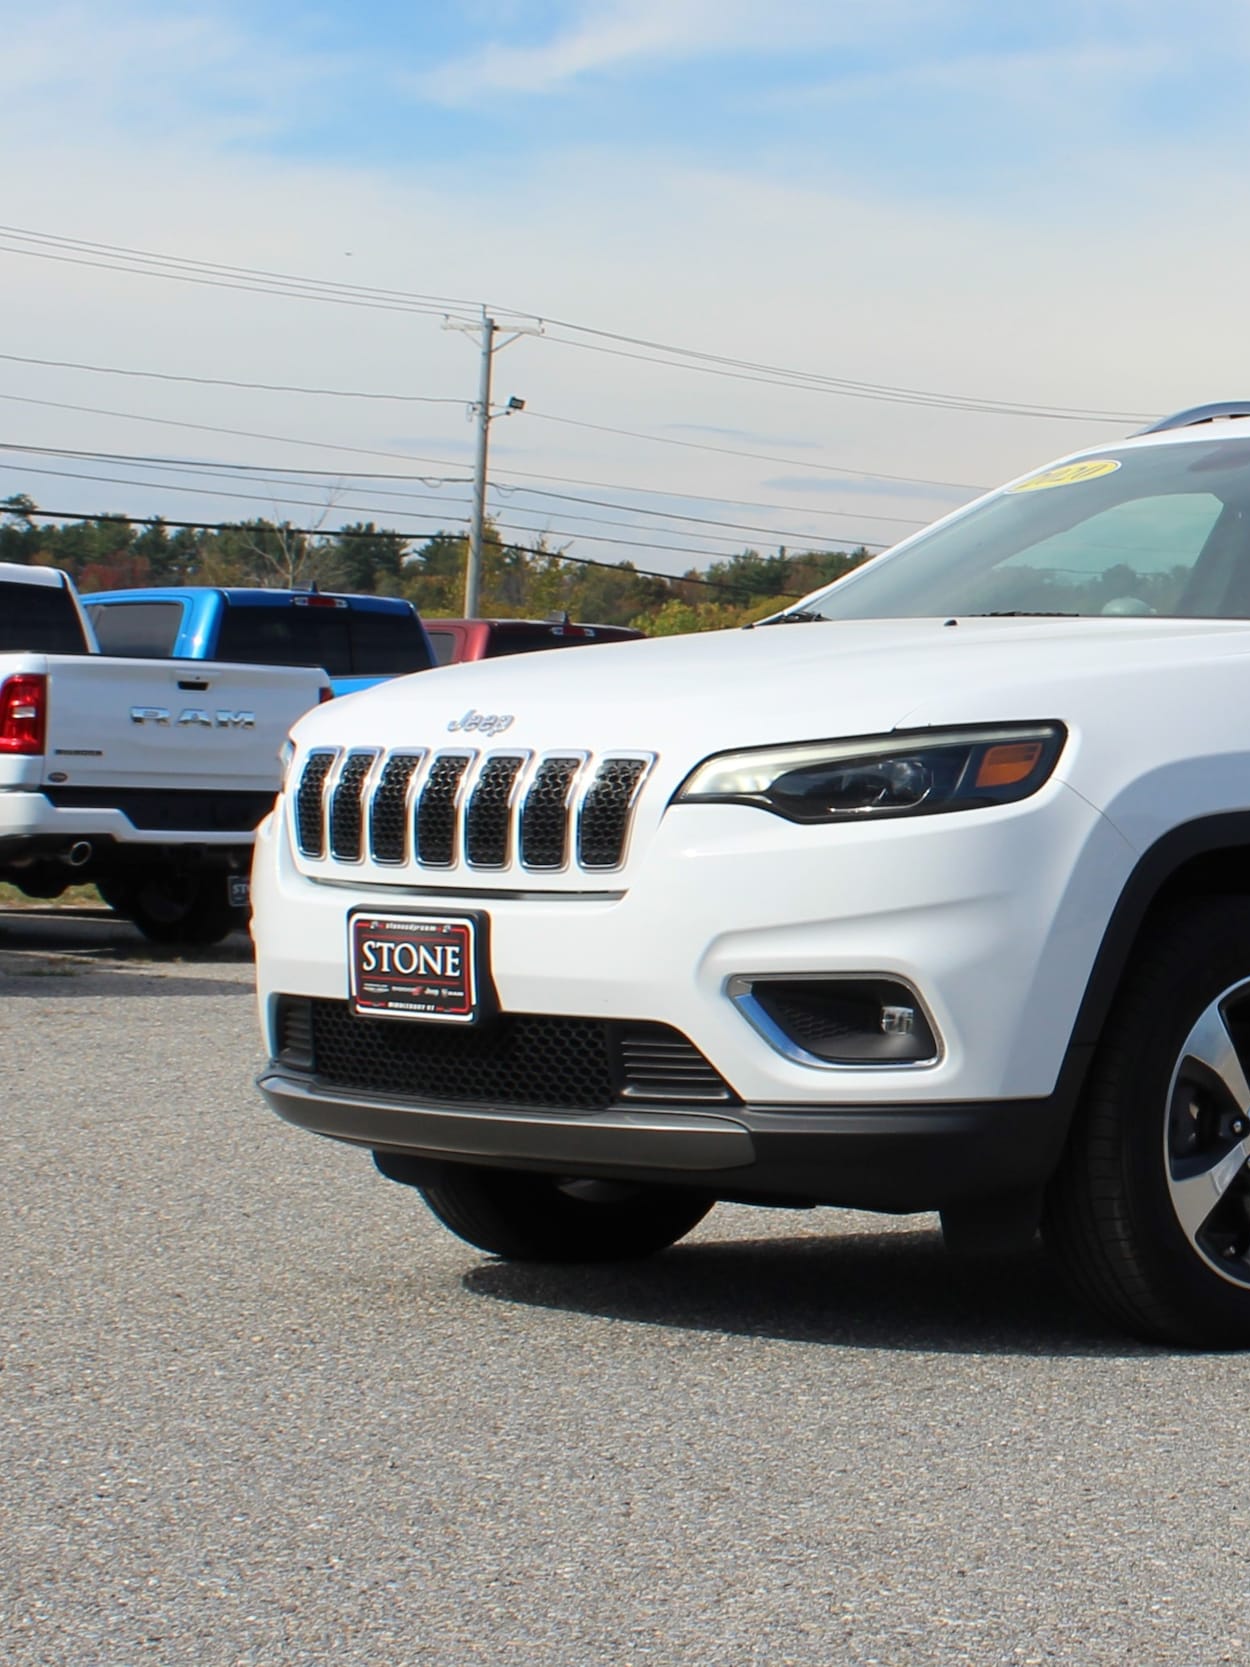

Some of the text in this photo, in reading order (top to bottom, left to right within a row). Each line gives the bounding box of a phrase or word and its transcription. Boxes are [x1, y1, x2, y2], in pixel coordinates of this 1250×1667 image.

[130, 705, 256, 729] RAM
[447, 709, 515, 737] Jeep
[361, 940, 460, 977] STONE
